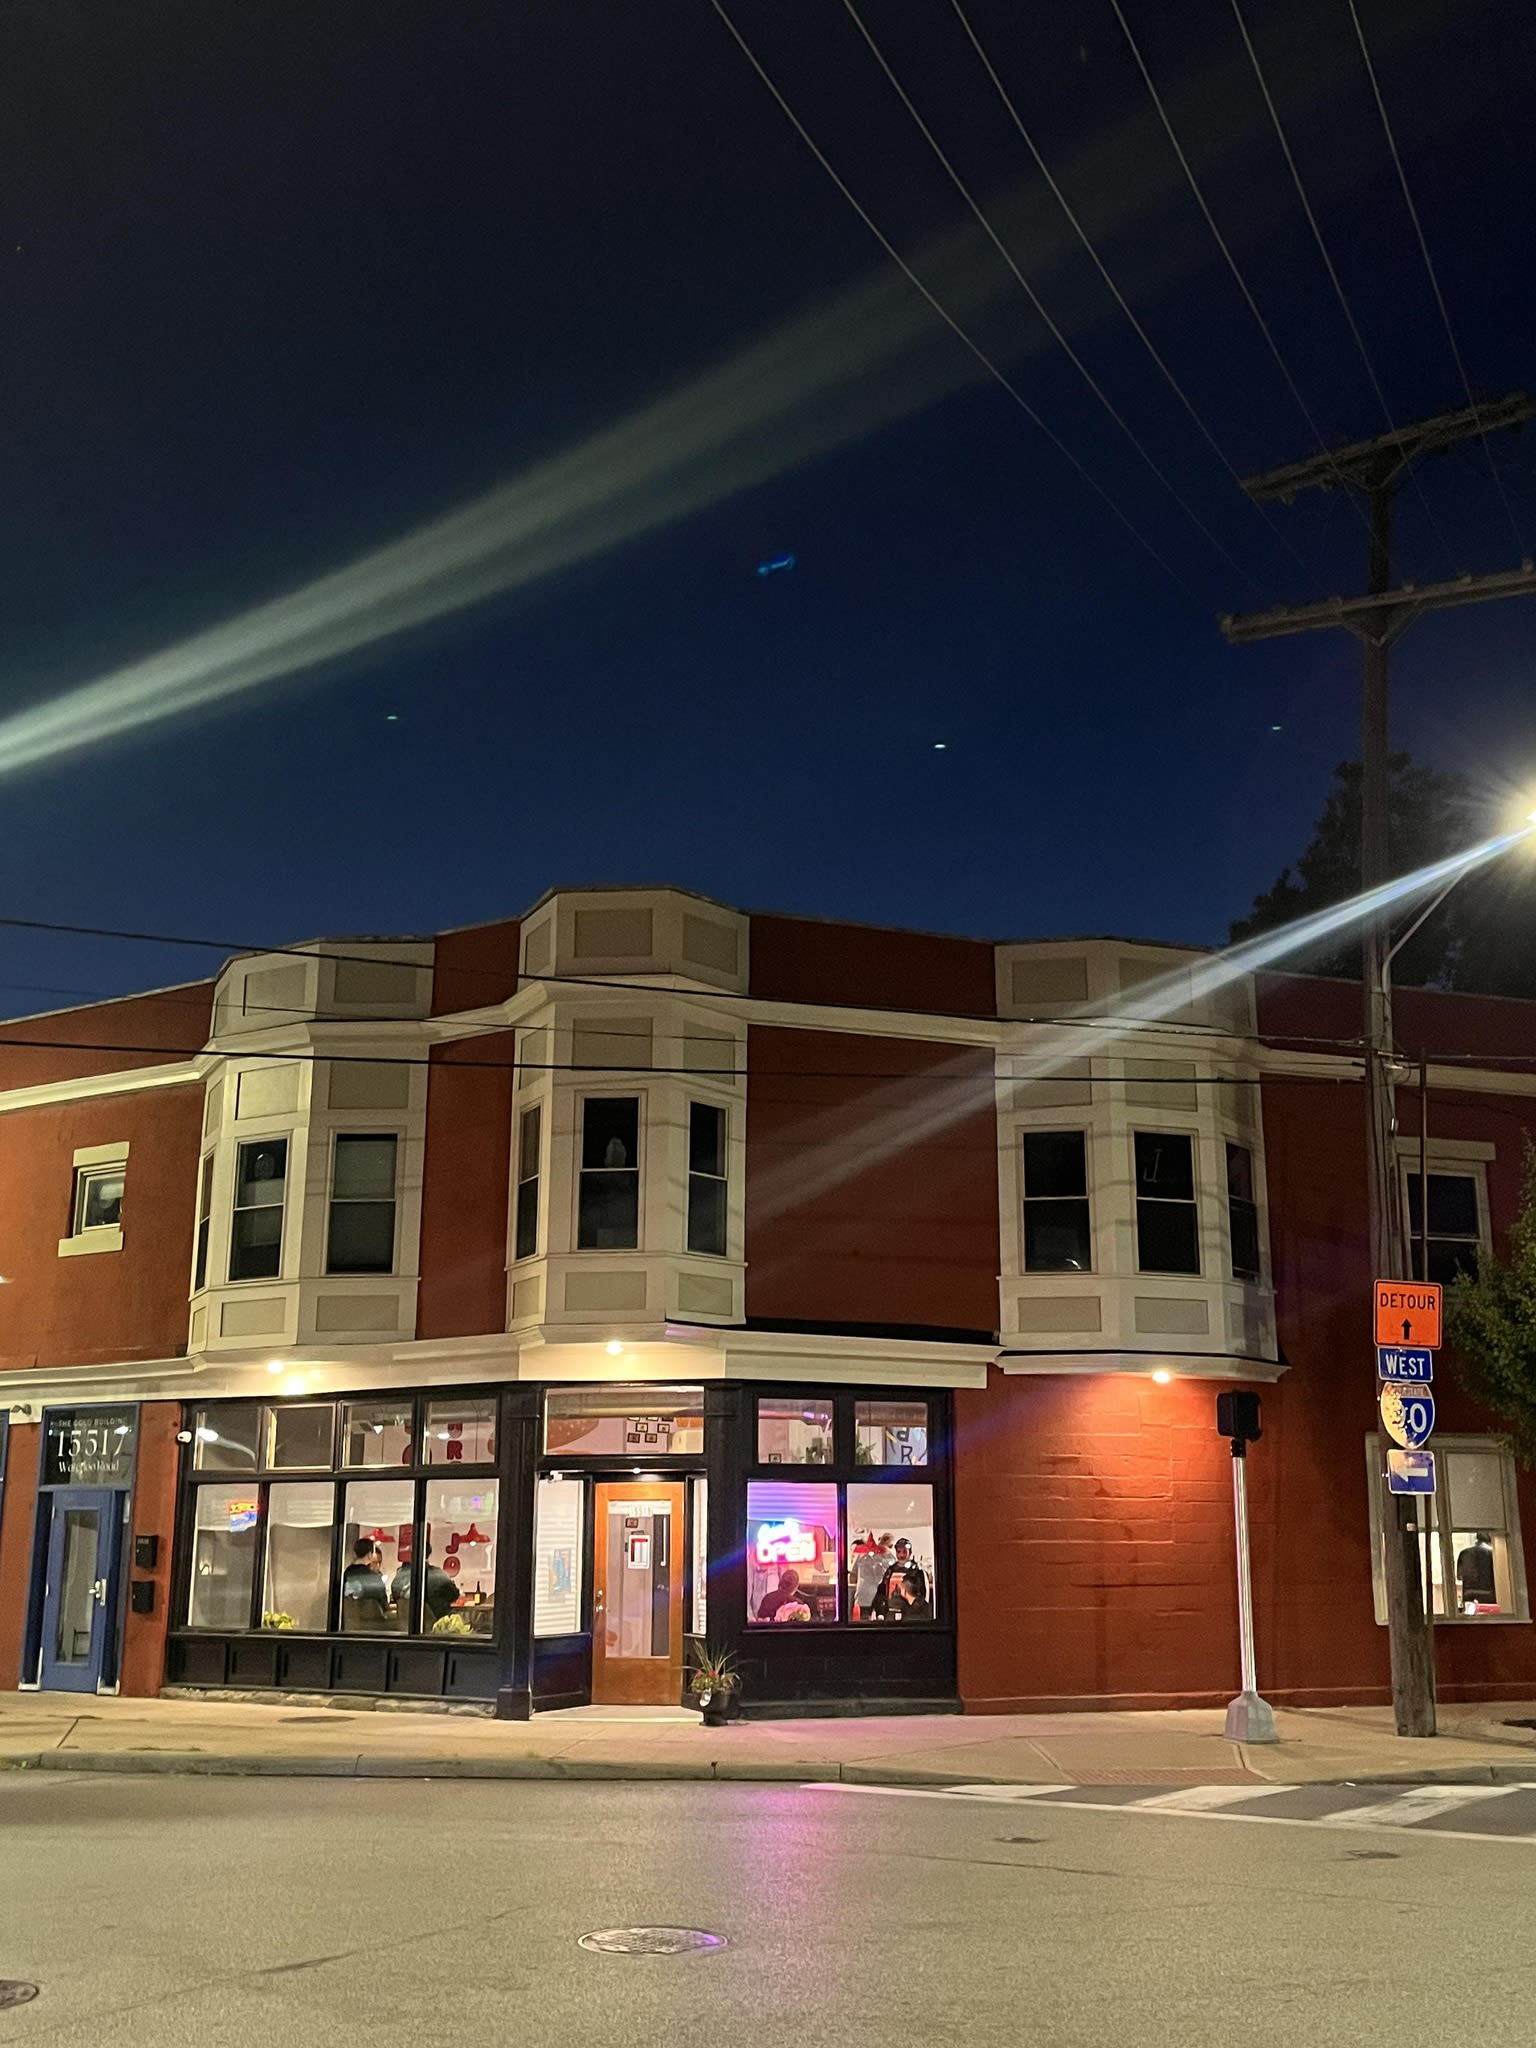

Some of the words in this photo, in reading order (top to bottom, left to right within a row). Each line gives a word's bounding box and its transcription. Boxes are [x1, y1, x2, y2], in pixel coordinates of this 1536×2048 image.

[1381, 1293, 1436, 1310] DETOUR
[1385, 1354, 1425, 1376] WEST
[58, 1428, 125, 1457] 15517
[757, 1542, 816, 1562] OPEN
